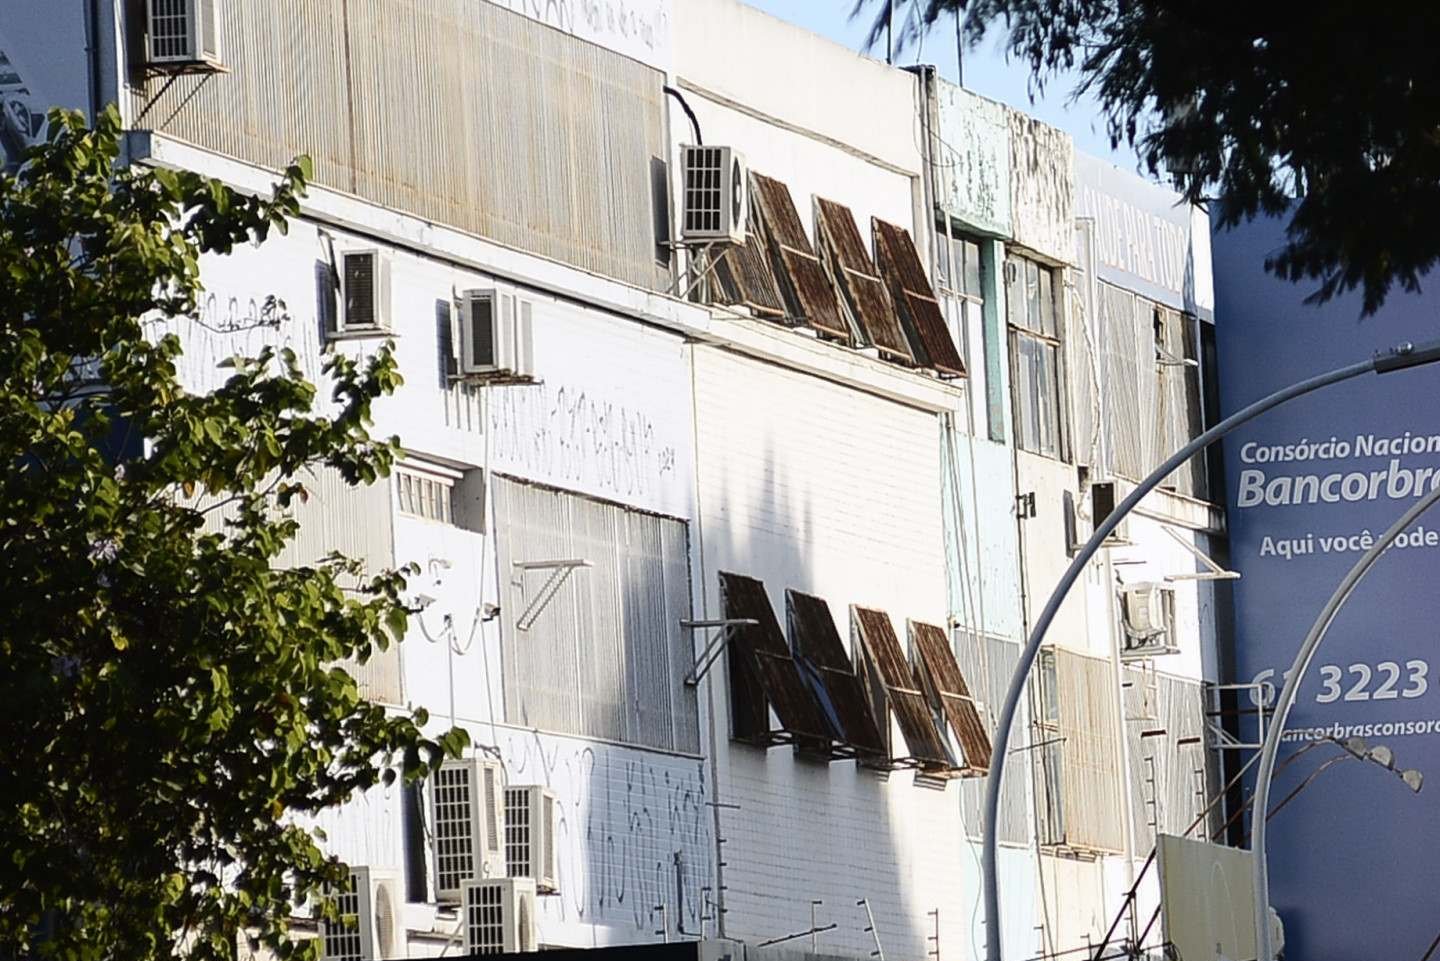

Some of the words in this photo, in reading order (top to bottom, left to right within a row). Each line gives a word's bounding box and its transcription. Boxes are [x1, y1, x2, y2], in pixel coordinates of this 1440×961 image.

[1240, 437, 1351, 463] Consórcio
[1260, 535, 1314, 560] Aqui
[1320, 531, 1374, 553] você
[1315, 660, 1428, 703] 3223
